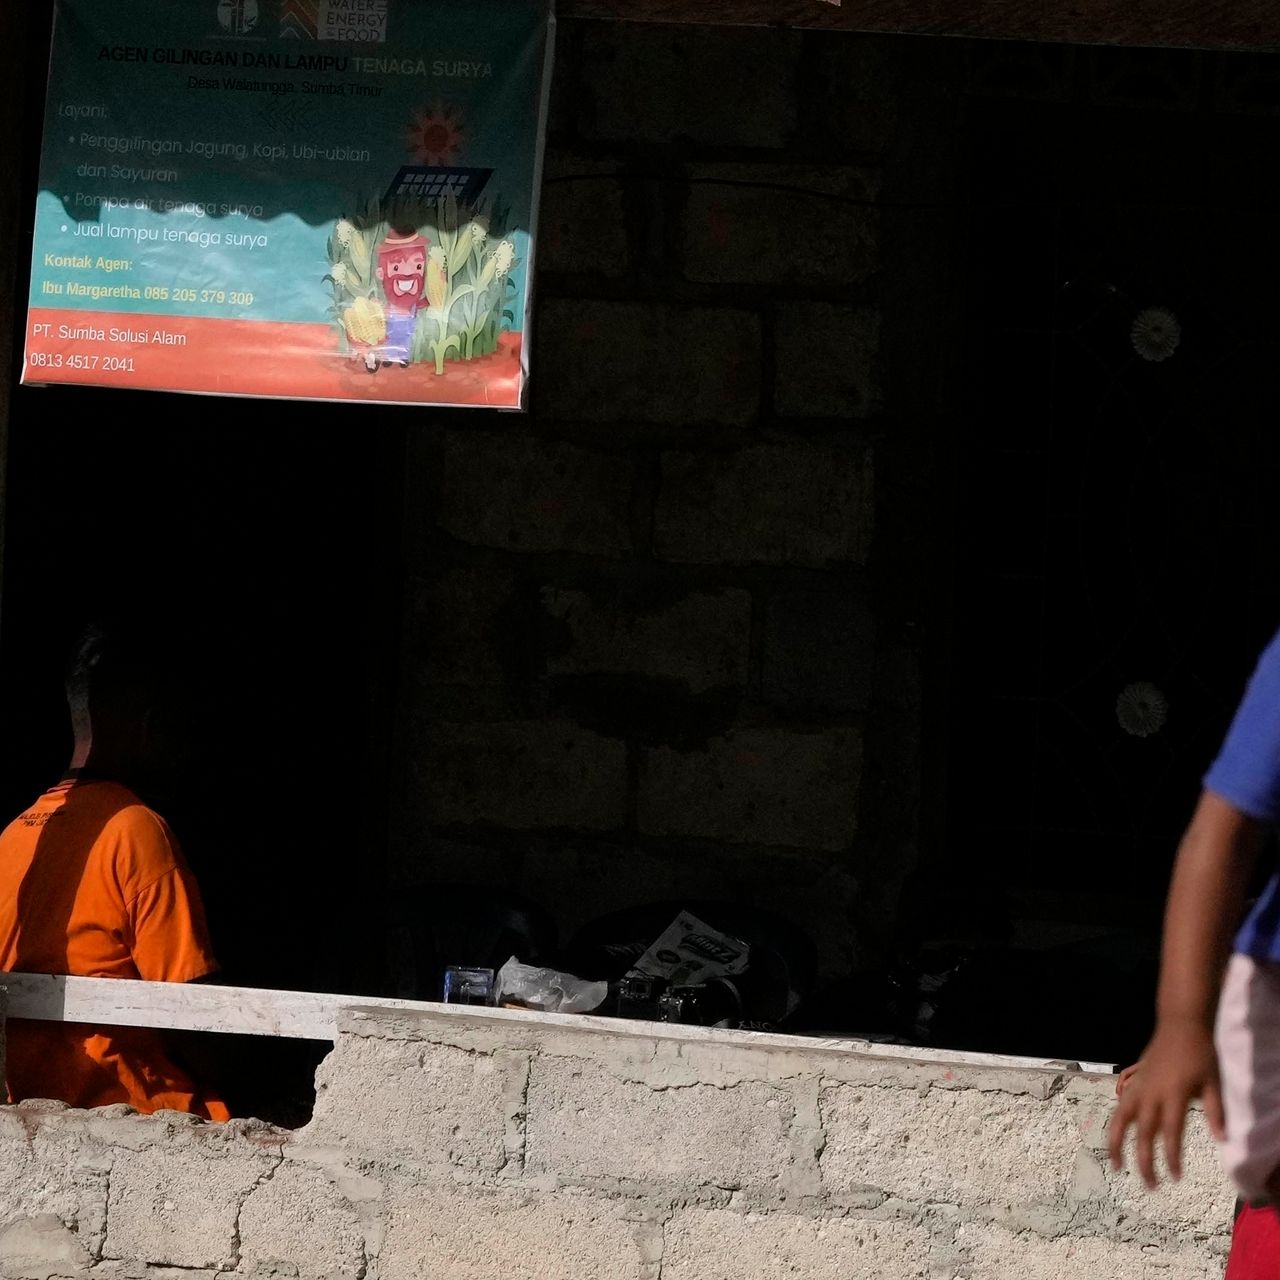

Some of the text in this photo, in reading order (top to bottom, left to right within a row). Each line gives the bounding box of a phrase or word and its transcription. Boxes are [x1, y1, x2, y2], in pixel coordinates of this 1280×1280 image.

[326, 12, 386, 27] ENERGY
[337, 28, 381, 42] FOOD
[97, 46, 494, 79] AGEN GILINGAN DAN LAMPU TENAGA SURYA
[188, 75, 220, 90] Desa
[349, 83, 384, 97] Timur
[80, 132, 370, 162] Penggilingan Jagung, Kopi, Ubi-ubian
[77, 162, 178, 184] dan Sayuran
[75, 192, 264, 220] Pompa air tenaga surya
[73, 223, 268, 250] Jual lampu tenaga surya
[44, 253, 133, 272] Kontak Agen:
[42, 280, 254, 305] Ibu Margaretha 085 205 379 300
[32, 323, 186, 345] PT. Sumba Solusi Alam
[30, 352, 136, 372] 0813 4517 2041
